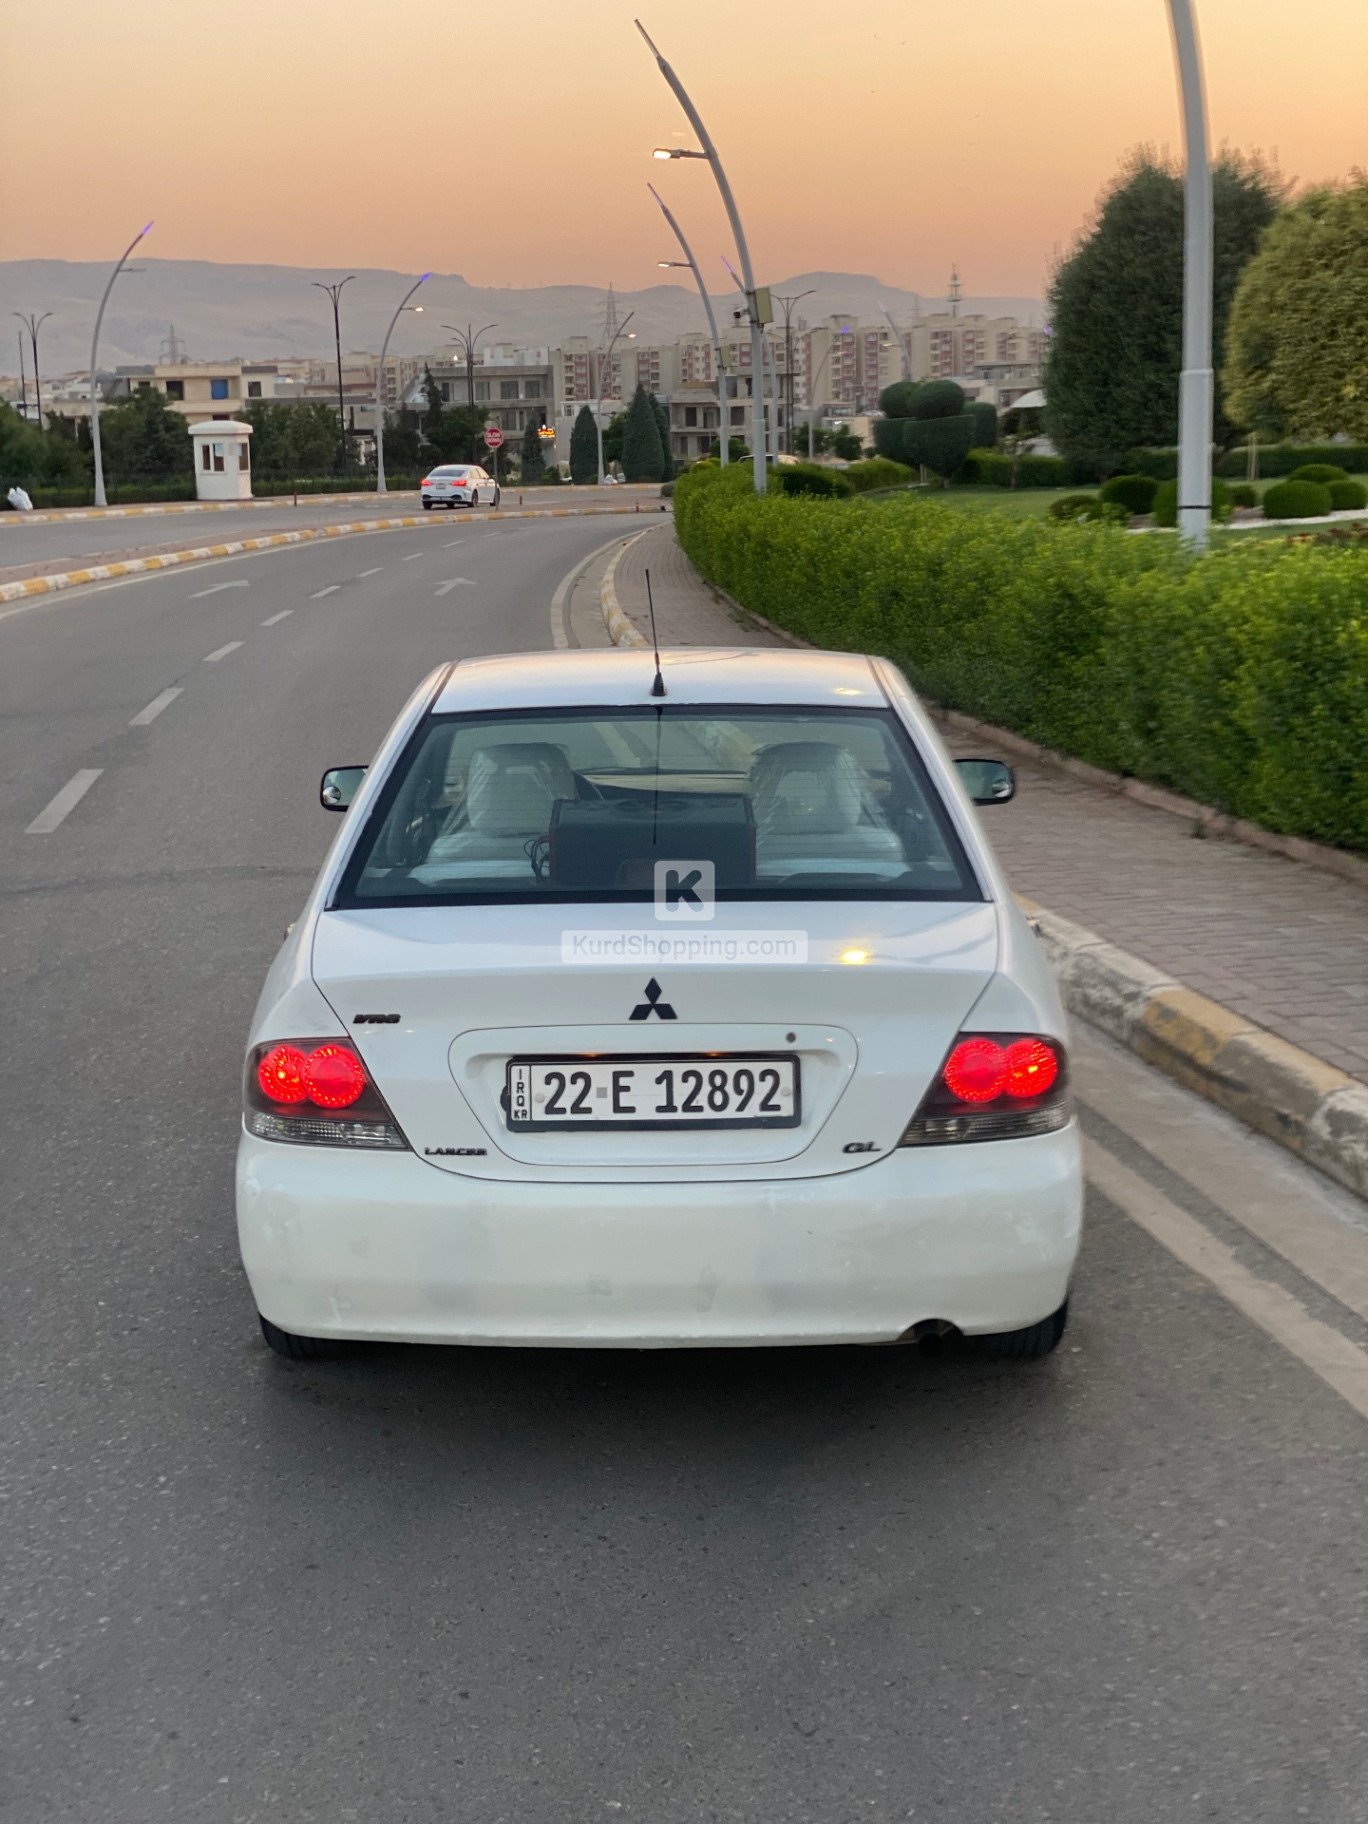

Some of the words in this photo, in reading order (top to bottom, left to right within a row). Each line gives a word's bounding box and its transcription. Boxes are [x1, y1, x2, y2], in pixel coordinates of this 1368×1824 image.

[544, 1071, 593, 1115] 22
[612, 1070, 636, 1113] E
[655, 1068, 782, 1114] 12892
[424, 1147, 488, 1156] LANCER
[842, 1141, 882, 1154] GL
